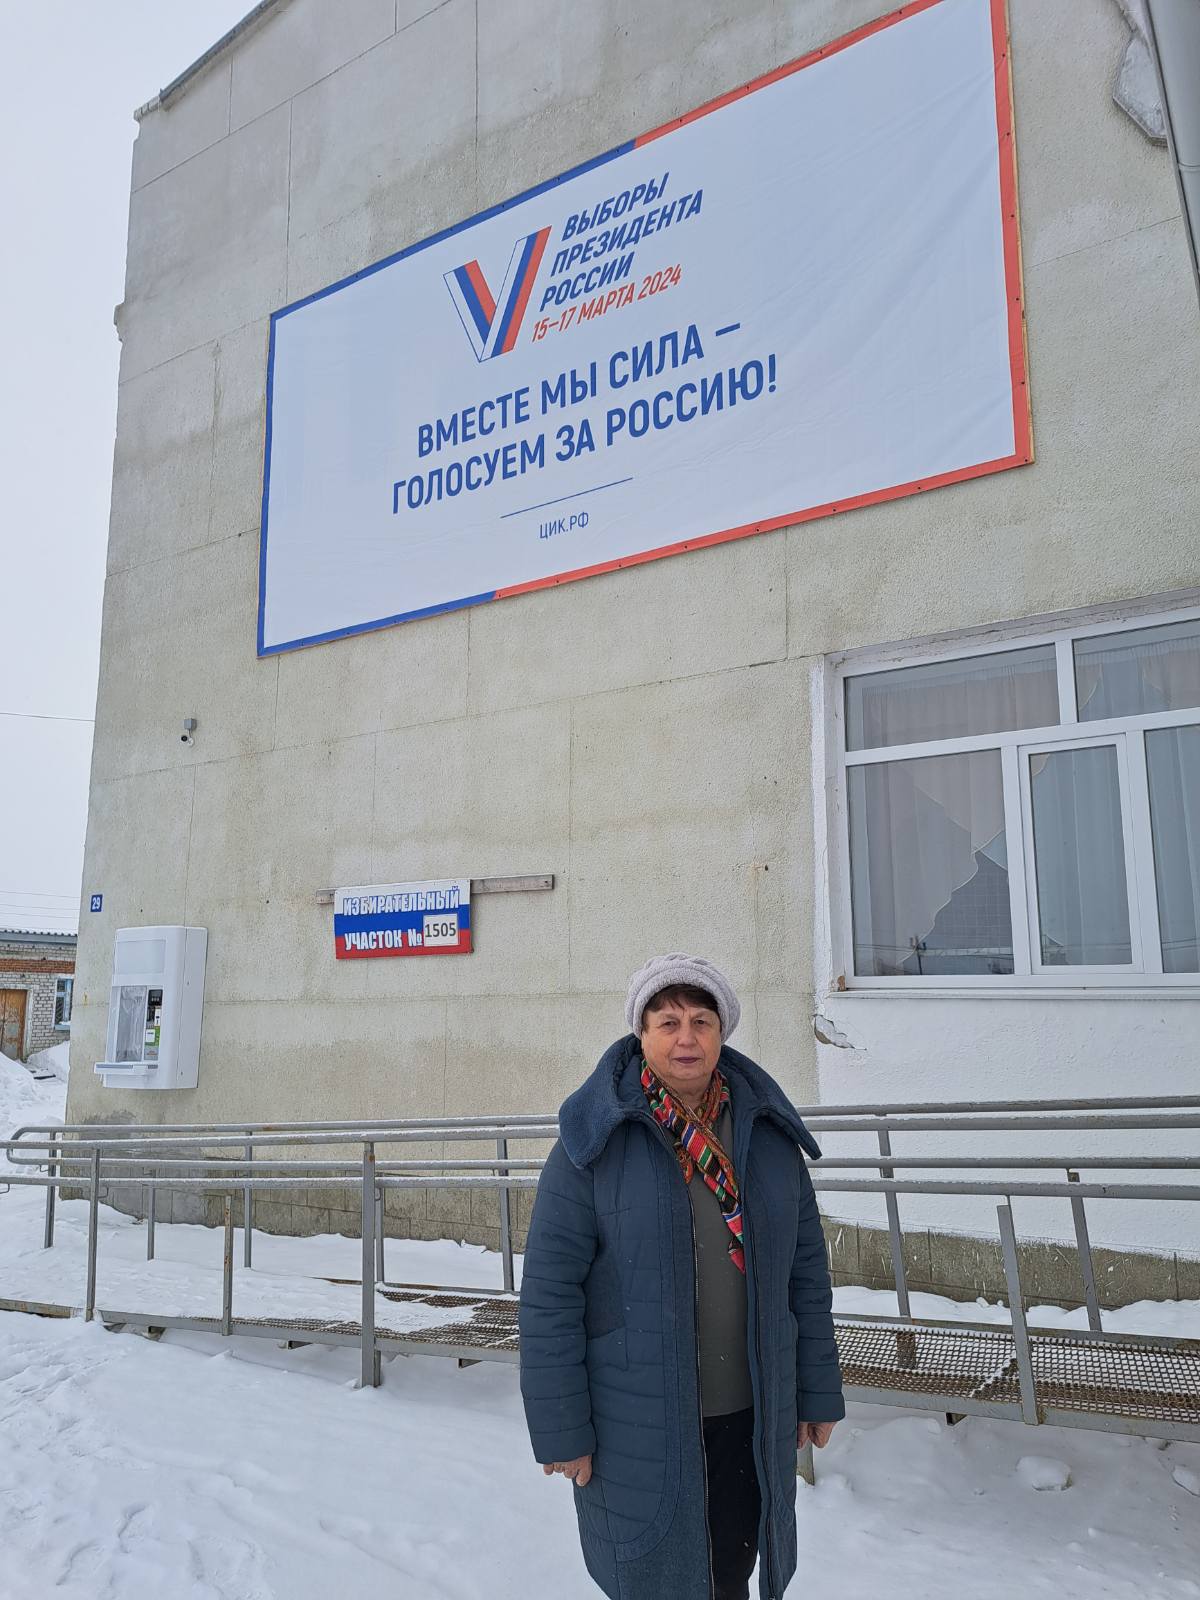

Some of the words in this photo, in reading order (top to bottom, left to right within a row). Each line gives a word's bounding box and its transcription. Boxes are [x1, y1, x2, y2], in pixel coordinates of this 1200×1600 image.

[550, 189, 704, 277] ПРЕЗИДЕНТА
[562, 172, 669, 242] ВЫБОРЫ
[540, 252, 635, 312] РОССИИ
[577, 283, 635, 326] МАРТА
[637, 263, 682, 300] 2024
[418, 387, 530, 458] ВМЕСТЕ
[541, 362, 597, 415] МЫ
[609, 324, 704, 389] СИЛА
[392, 433, 545, 514] ГОЛОСУЕМ
[555, 418, 596, 462] ЗА
[606, 354, 777, 446] РОССИЮ!
[539, 511, 590, 540] ЦИК.РФ
[91, 896, 101, 910] 29
[343, 886, 461, 916] ИЗБИРАТЕЛЬНЫЙ
[344, 929, 403, 951] УЧАСТОК
[407, 928, 423, 946] №
[424, 922, 457, 938] 1505
